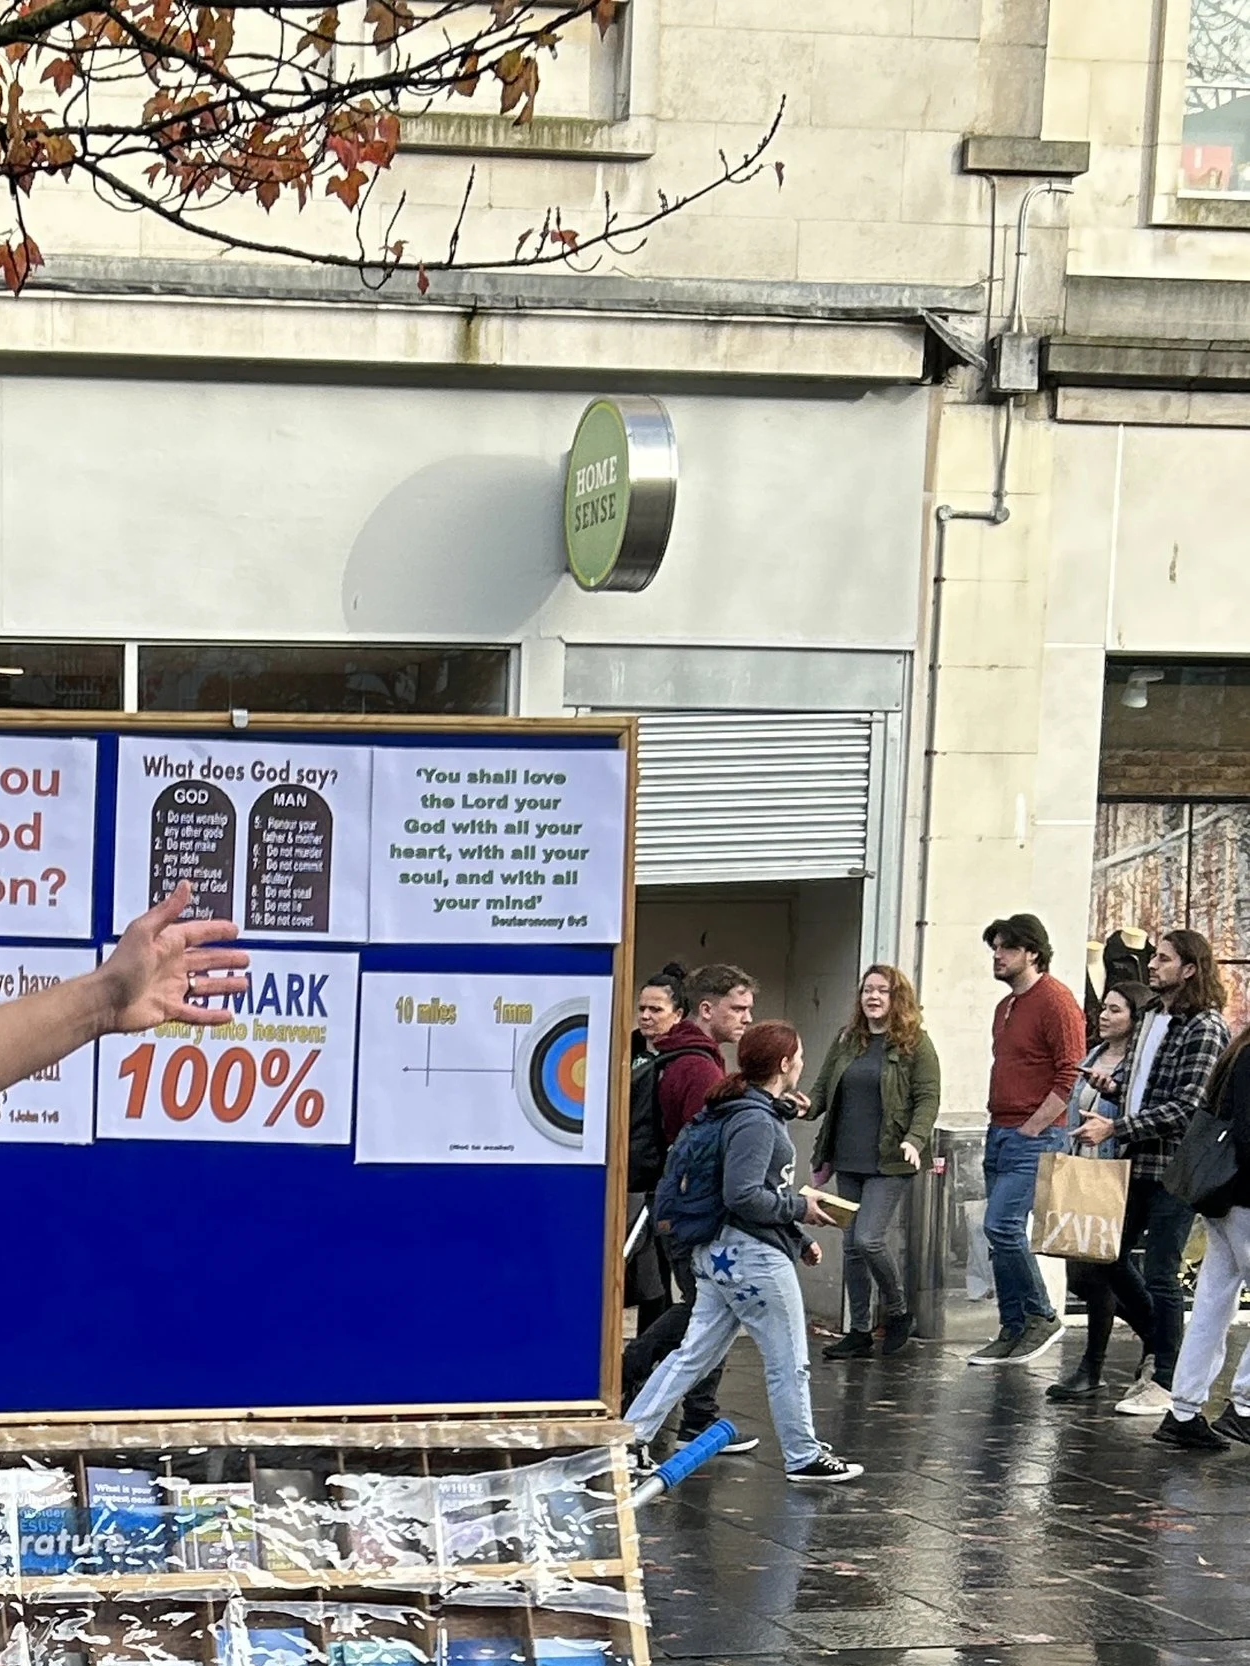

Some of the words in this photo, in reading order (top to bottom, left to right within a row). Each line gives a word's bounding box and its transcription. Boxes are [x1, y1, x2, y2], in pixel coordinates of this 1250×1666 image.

[575, 455, 618, 497] HOME
[575, 492, 616, 532] SENSE
[143, 755, 194, 777] What
[200, 757, 244, 781] does
[251, 760, 290, 783] God
[297, 769, 338, 790] say?
[467, 769, 517, 784] shall
[524, 769, 566, 785] love
[174, 789, 208, 804] GOD
[273, 793, 307, 807] MAN
[421, 794, 454, 809] the
[462, 794, 508, 809] Lord
[515, 798, 561, 813] your
[168, 810, 179, 823] Do
[181, 812, 194, 824] not
[196, 812, 228, 827] worship
[404, 819, 445, 834] God
[452, 819, 497, 834] with
[504, 820, 528, 835] all
[535, 823, 582, 838] your
[167, 838, 178, 850] Do
[180, 840, 193, 851] not
[390, 844, 451, 862] heart,
[458, 844, 504, 860] with
[511, 845, 536, 860] all
[542, 848, 589, 863] your
[166, 865, 177, 877] Do
[179, 867, 192, 878] not
[399, 870, 449, 887] soul,
[456, 870, 493, 885] and
[500, 870, 545, 885] with
[552, 871, 578, 885] all
[433, 896, 480, 912] your
[222, 971, 329, 1018] MARK
[396, 996, 413, 1024] 10
[417, 997, 457, 1025] miles
[494, 996, 532, 1024] 1mm
[253, 1018, 326, 1044] heaven:
[118, 1043, 325, 1128] 100%
